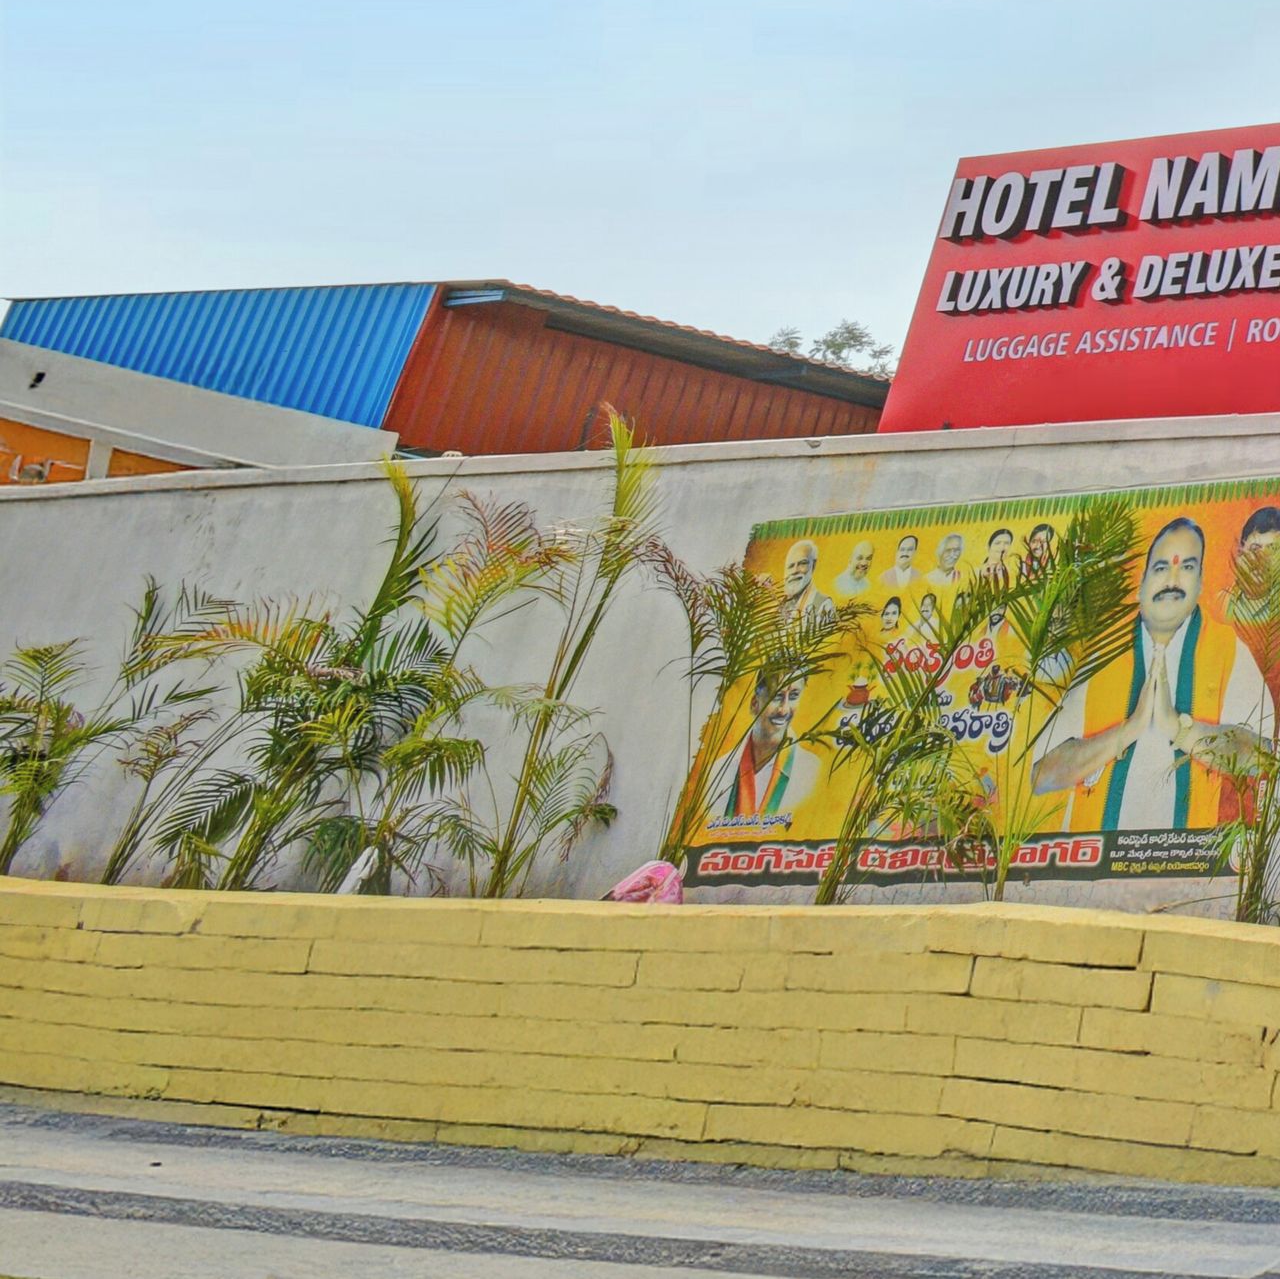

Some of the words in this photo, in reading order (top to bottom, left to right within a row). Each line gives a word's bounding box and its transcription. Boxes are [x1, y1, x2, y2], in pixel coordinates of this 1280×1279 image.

[938, 162, 1122, 239] HOTEL
[936, 261, 1086, 312] LUXURY
[1091, 257, 1122, 301] &
[963, 332, 1072, 363] LUGGAGE
[1075, 322, 1220, 355] ASSISTANCE
[1111, 861, 1129, 871] MBC
